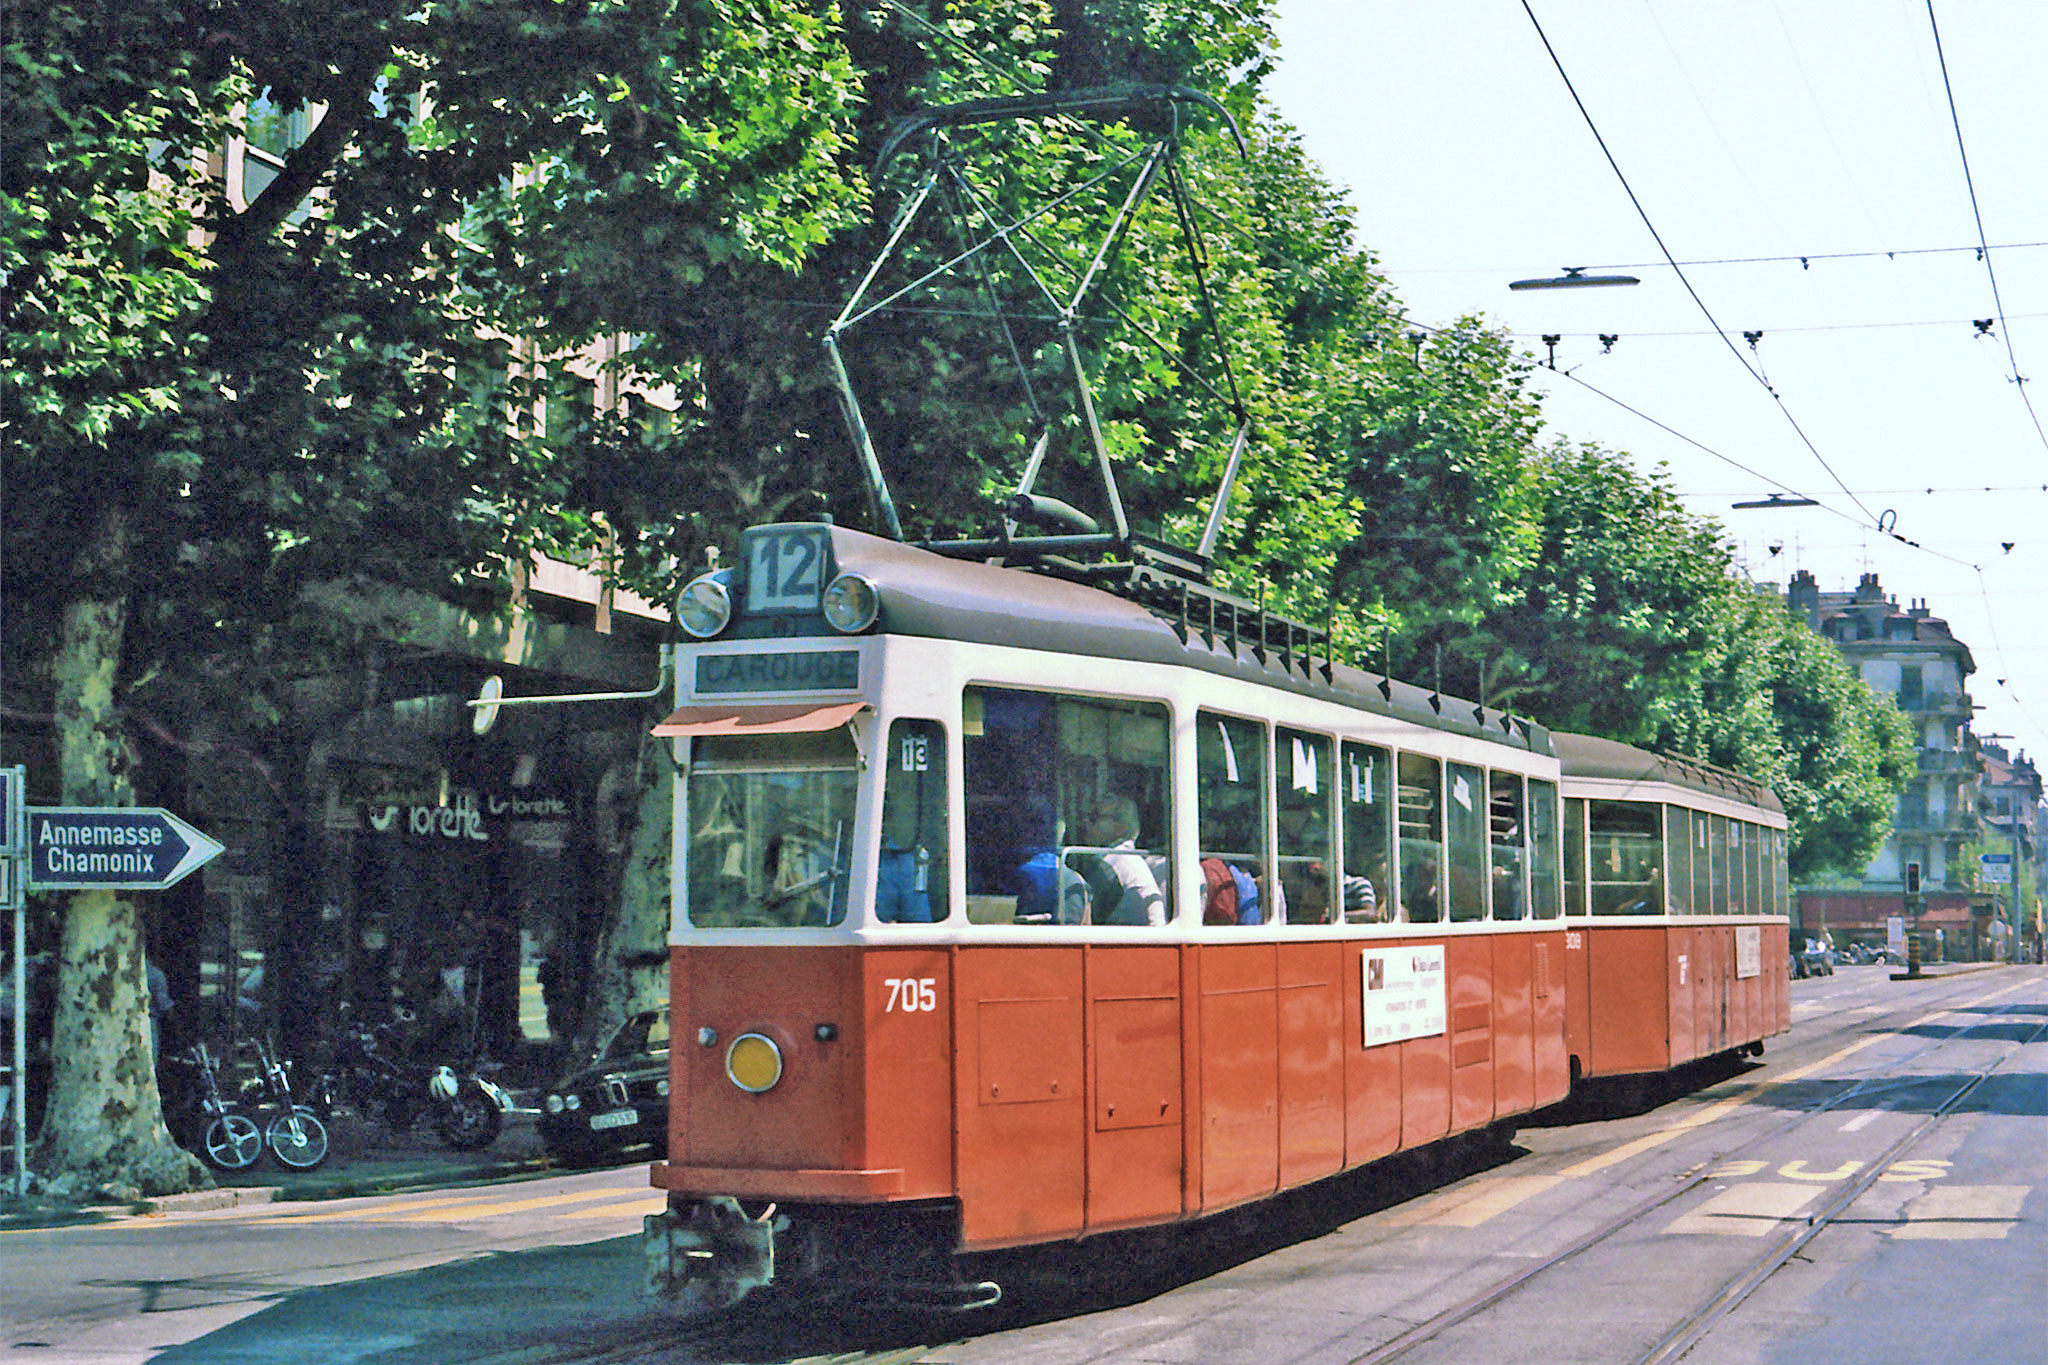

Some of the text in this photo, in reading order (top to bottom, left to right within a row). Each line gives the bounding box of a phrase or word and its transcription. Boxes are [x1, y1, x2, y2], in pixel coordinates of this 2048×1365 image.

[760, 534, 817, 598] 12
[705, 652, 855, 682] CAROUGE
[39, 819, 163, 846] Annemasse
[47, 846, 155, 873] Chamonix
[884, 978, 937, 1013] 705
